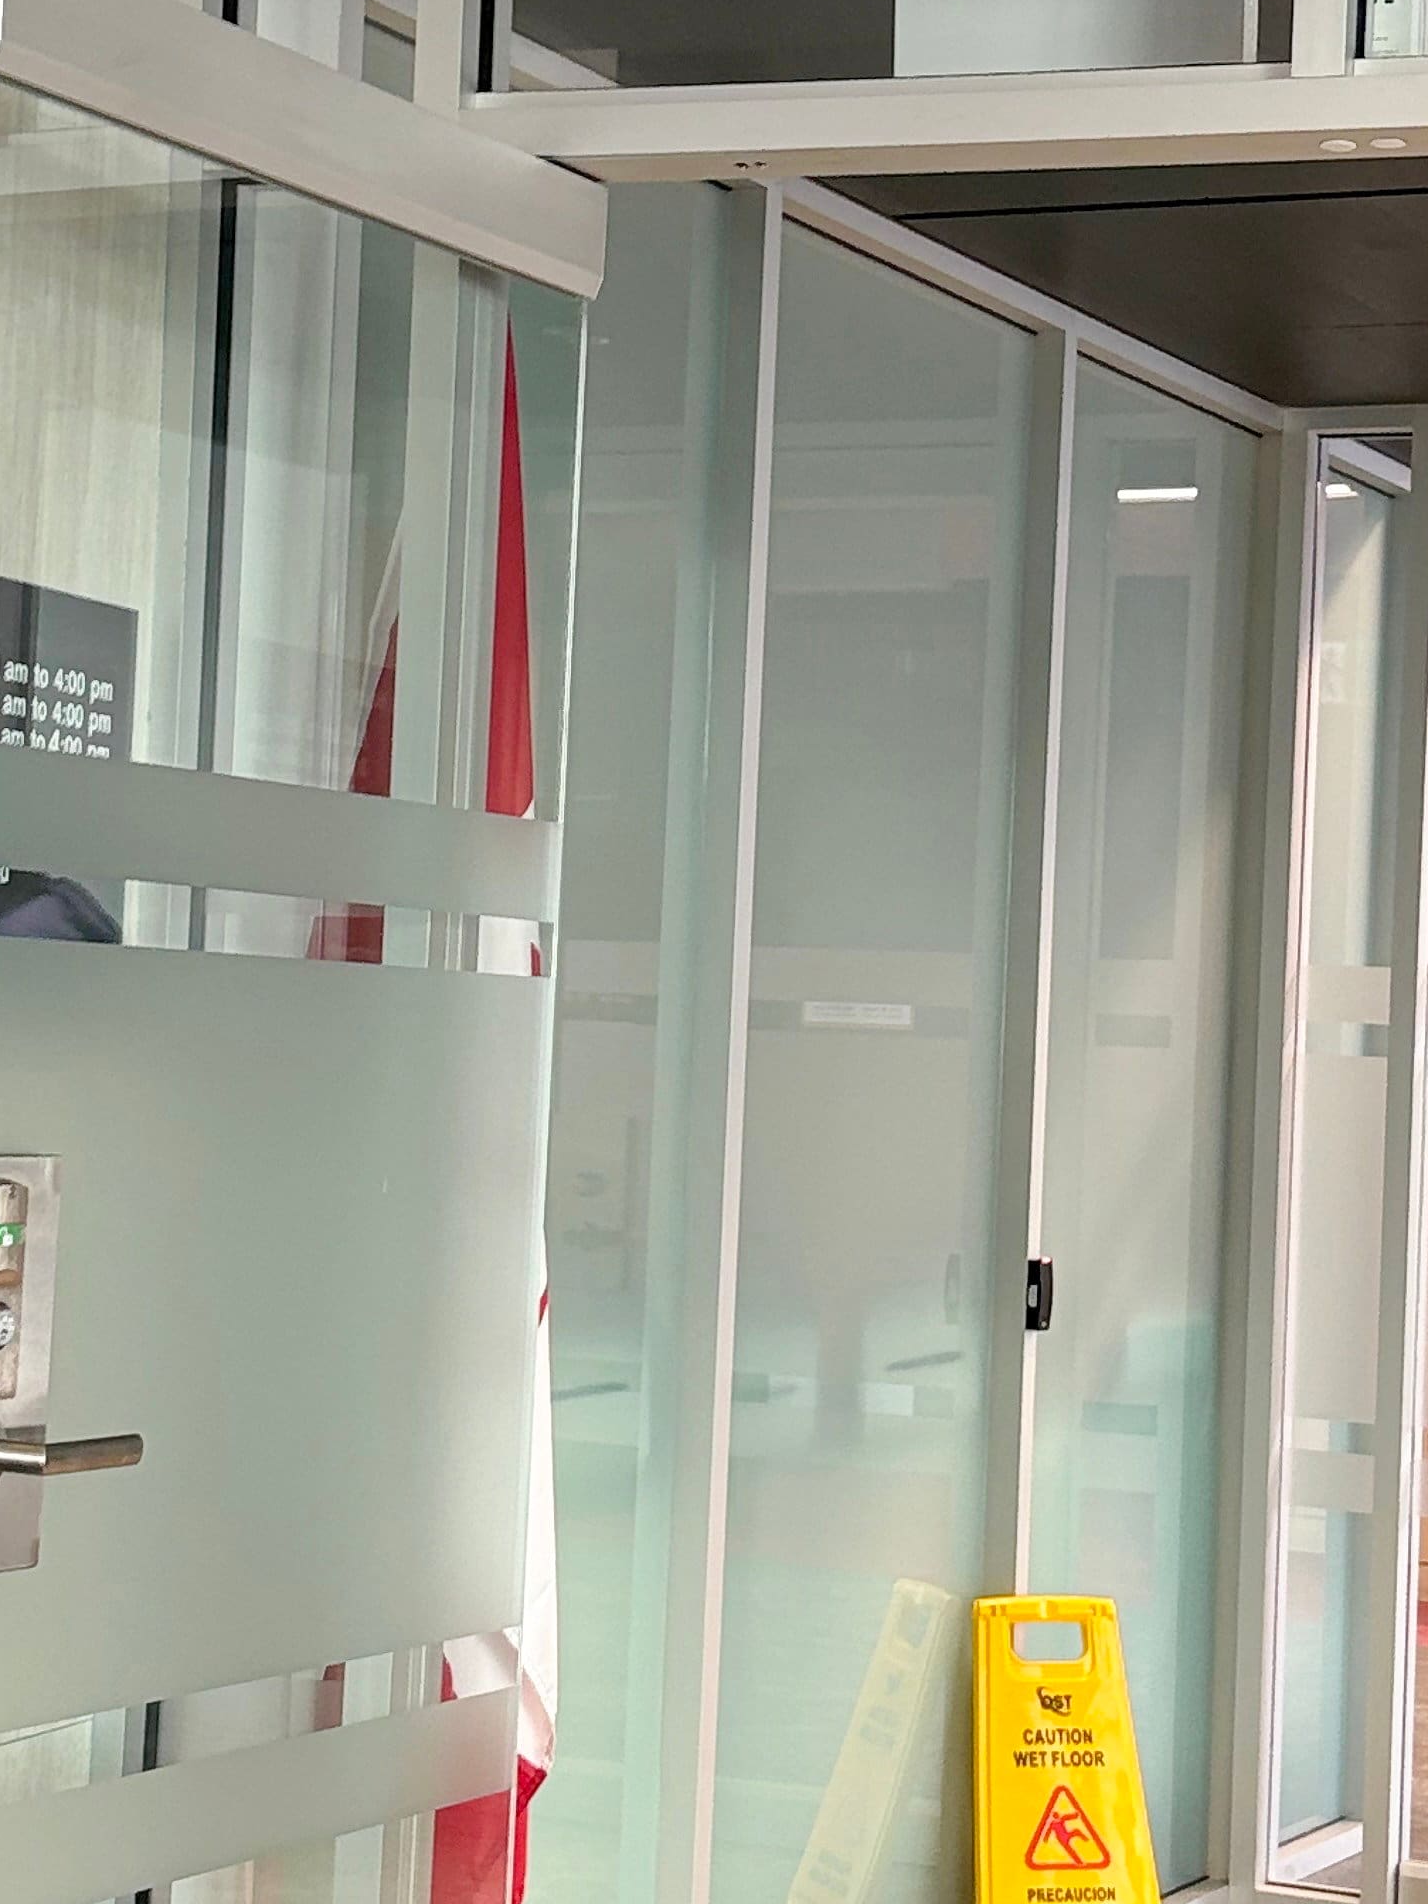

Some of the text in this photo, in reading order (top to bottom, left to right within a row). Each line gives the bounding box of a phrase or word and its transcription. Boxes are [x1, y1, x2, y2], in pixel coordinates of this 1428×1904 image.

[3, 660, 28, 685] am
[33, 663, 49, 689] to
[53, 668, 85, 696] 4:00
[89, 679, 113, 704] pm
[2, 694, 26, 718] am
[32, 696, 47, 721] to
[51, 701, 84, 729] 4:00
[88, 711, 111, 737] pm
[0, 727, 24, 746] am
[30, 728, 45, 749] to
[1022, 1728, 1093, 1745] CAUTION
[1013, 1750, 1105, 1768] WET FLOOR
[1027, 1887, 1116, 1903] PRECAUCION
